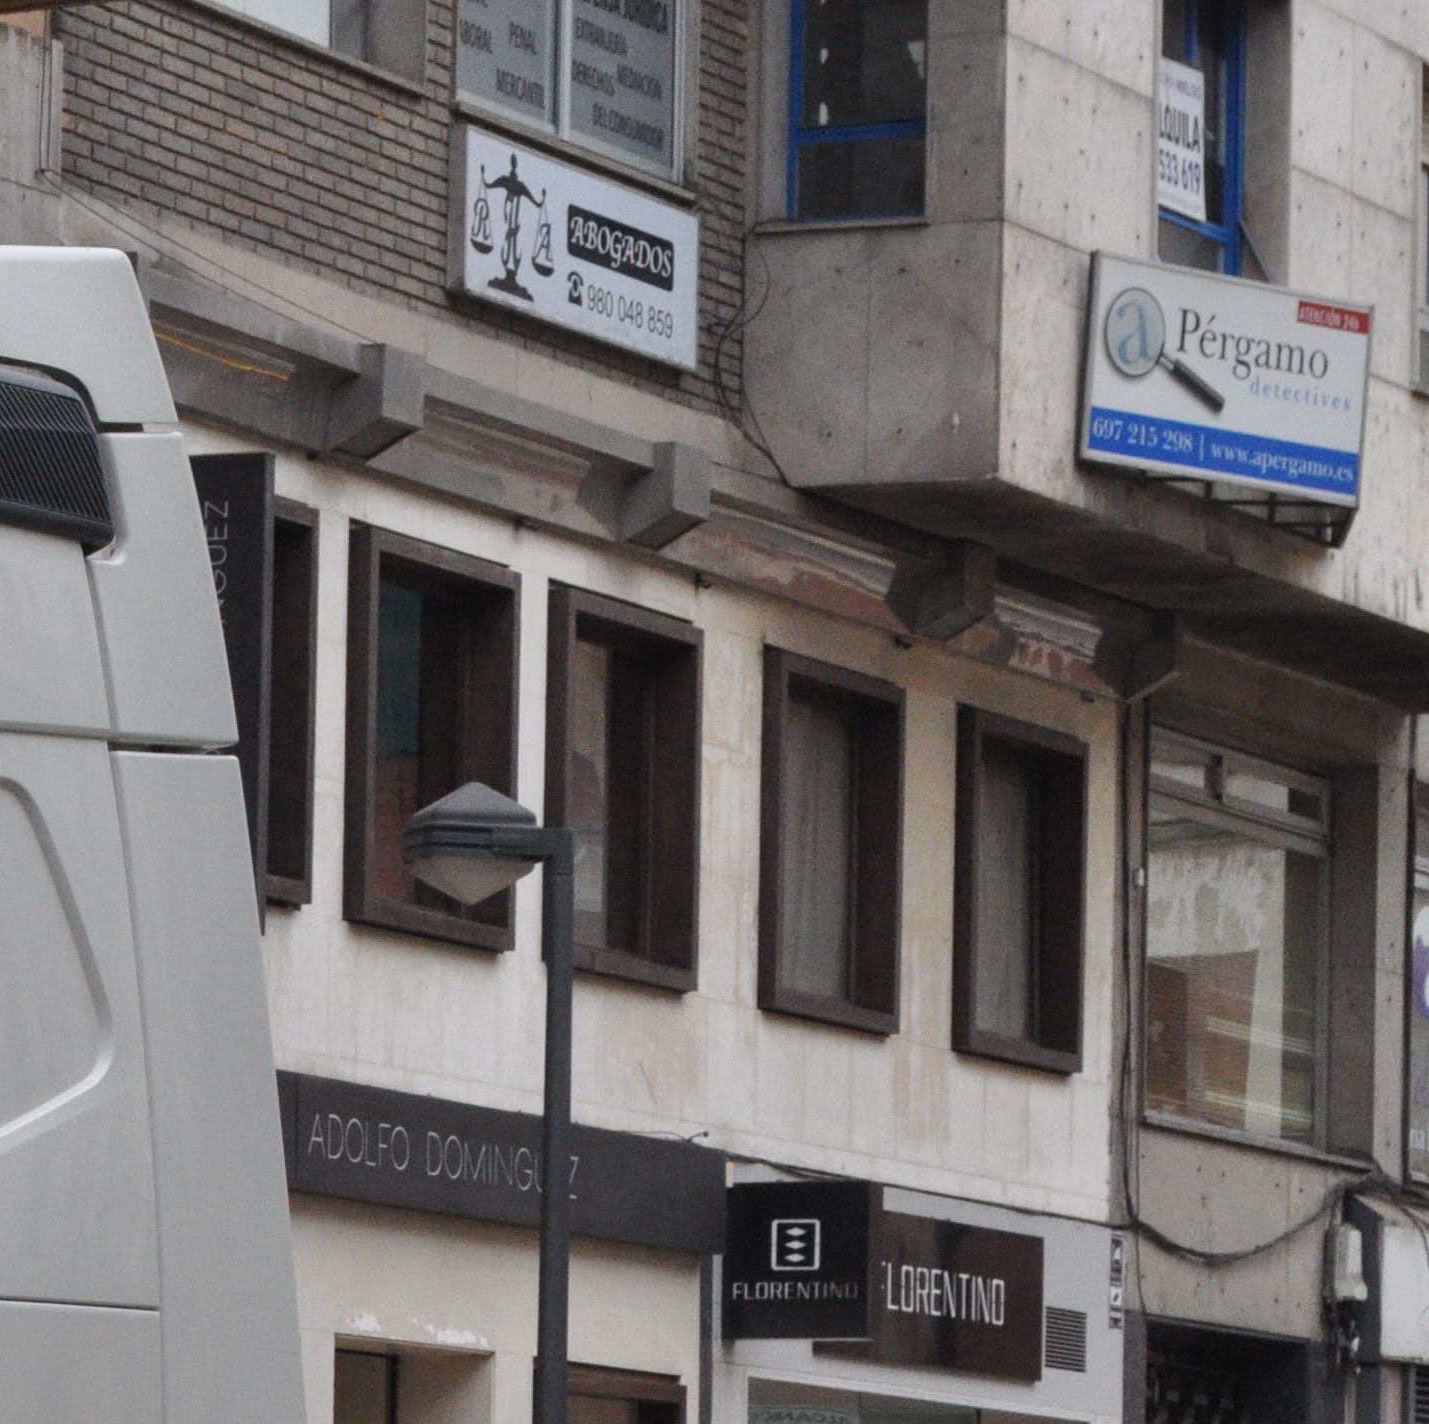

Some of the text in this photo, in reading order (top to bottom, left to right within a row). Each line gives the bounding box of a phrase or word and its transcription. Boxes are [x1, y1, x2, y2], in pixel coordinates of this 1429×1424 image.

[1181, 158, 1200, 195] 619
[569, 217, 672, 277] ABOGADOS
[587, 285, 673, 338] 980 048 859
[1177, 306, 1329, 381] Pérgamo
[1249, 375, 1351, 412] detectives
[1093, 416, 1353, 482] 697 215 298 www.apergamo.es
[308, 1113, 410, 1171] ADOLFO
[732, 1280, 859, 1300] FLORENTINO
[882, 1261, 1005, 1326] LORENTINO
